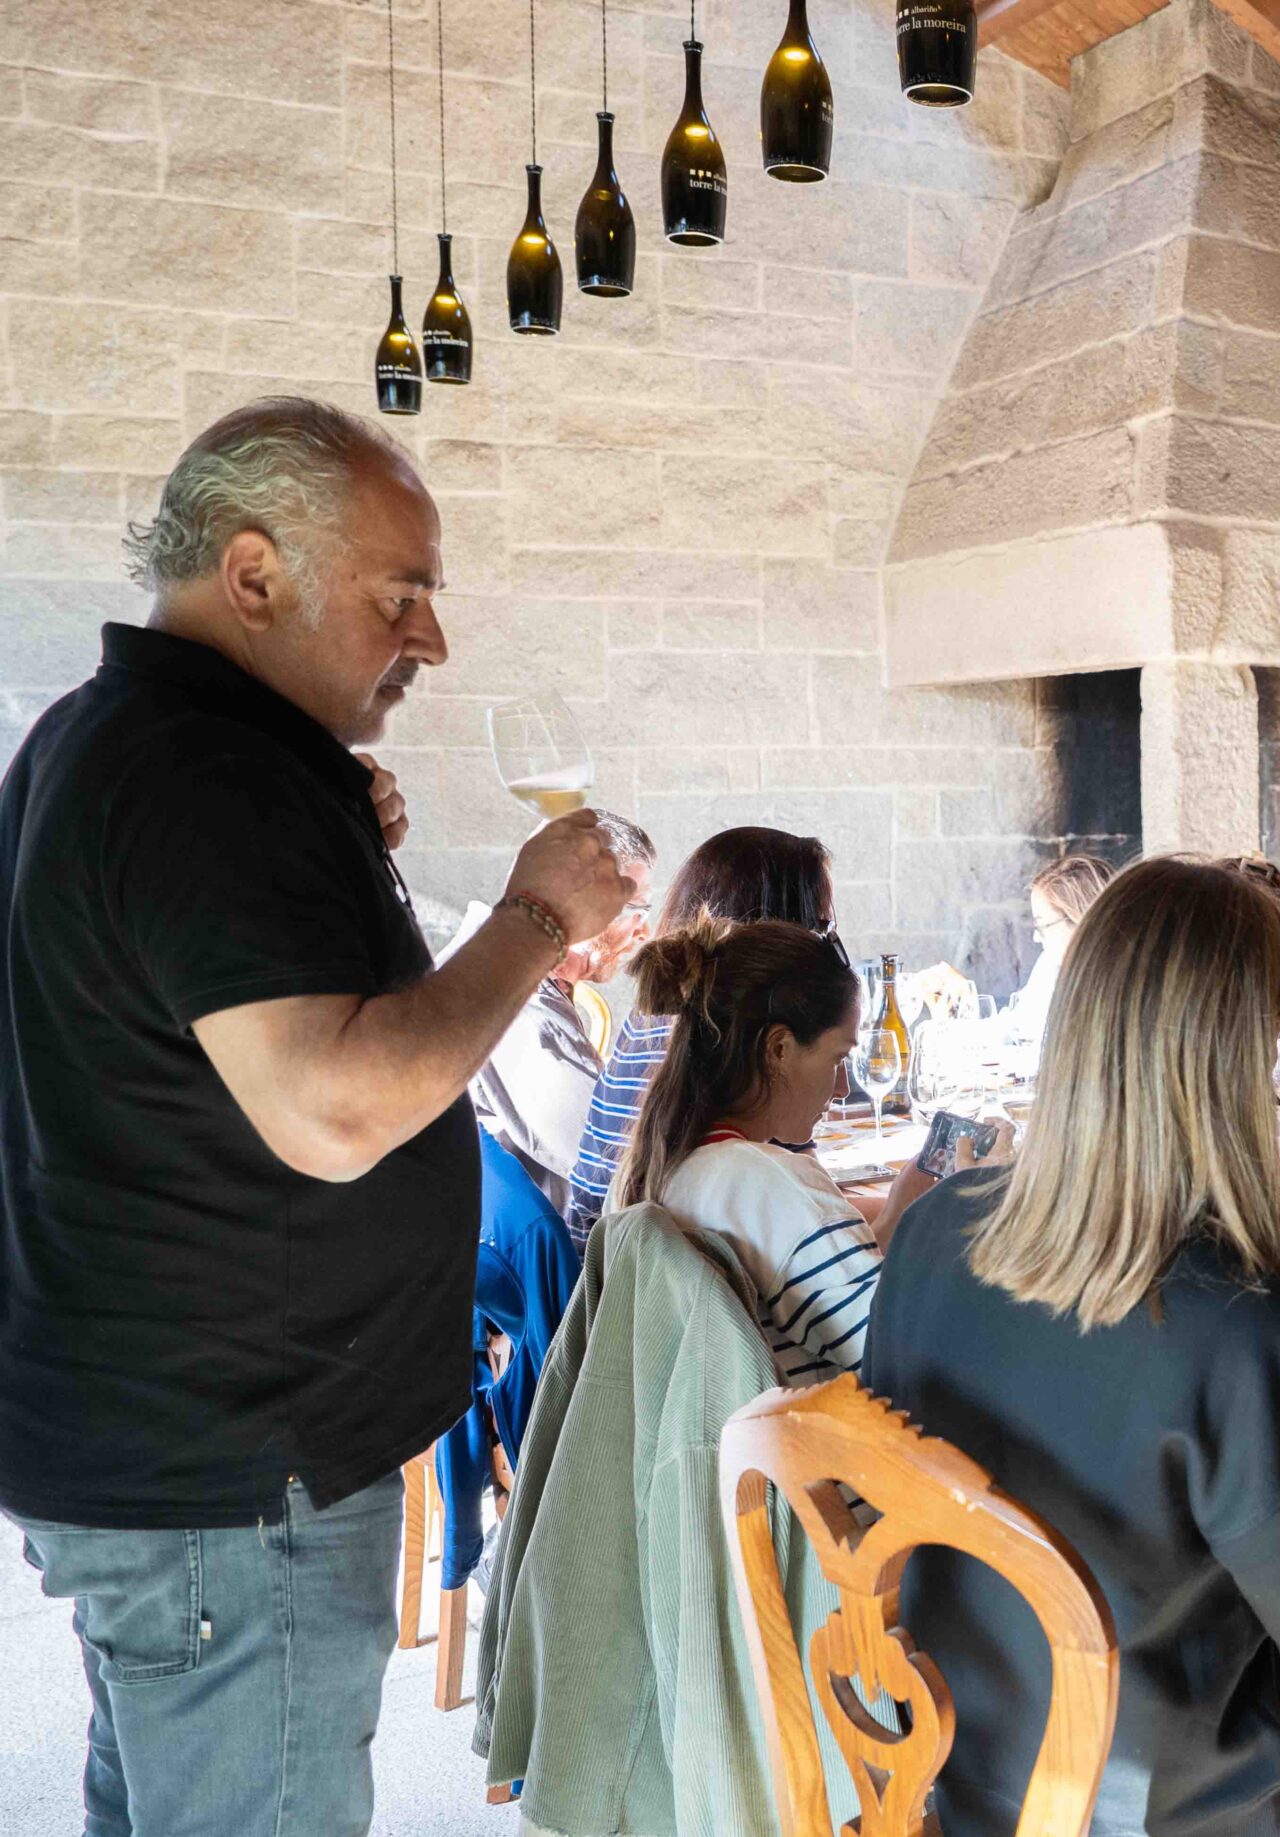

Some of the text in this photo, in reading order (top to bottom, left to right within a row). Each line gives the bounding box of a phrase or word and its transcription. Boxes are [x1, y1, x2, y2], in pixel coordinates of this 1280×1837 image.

[912, 16, 922, 30] la
[923, 18, 967, 34] moreira
[689, 179, 713, 190] torre
